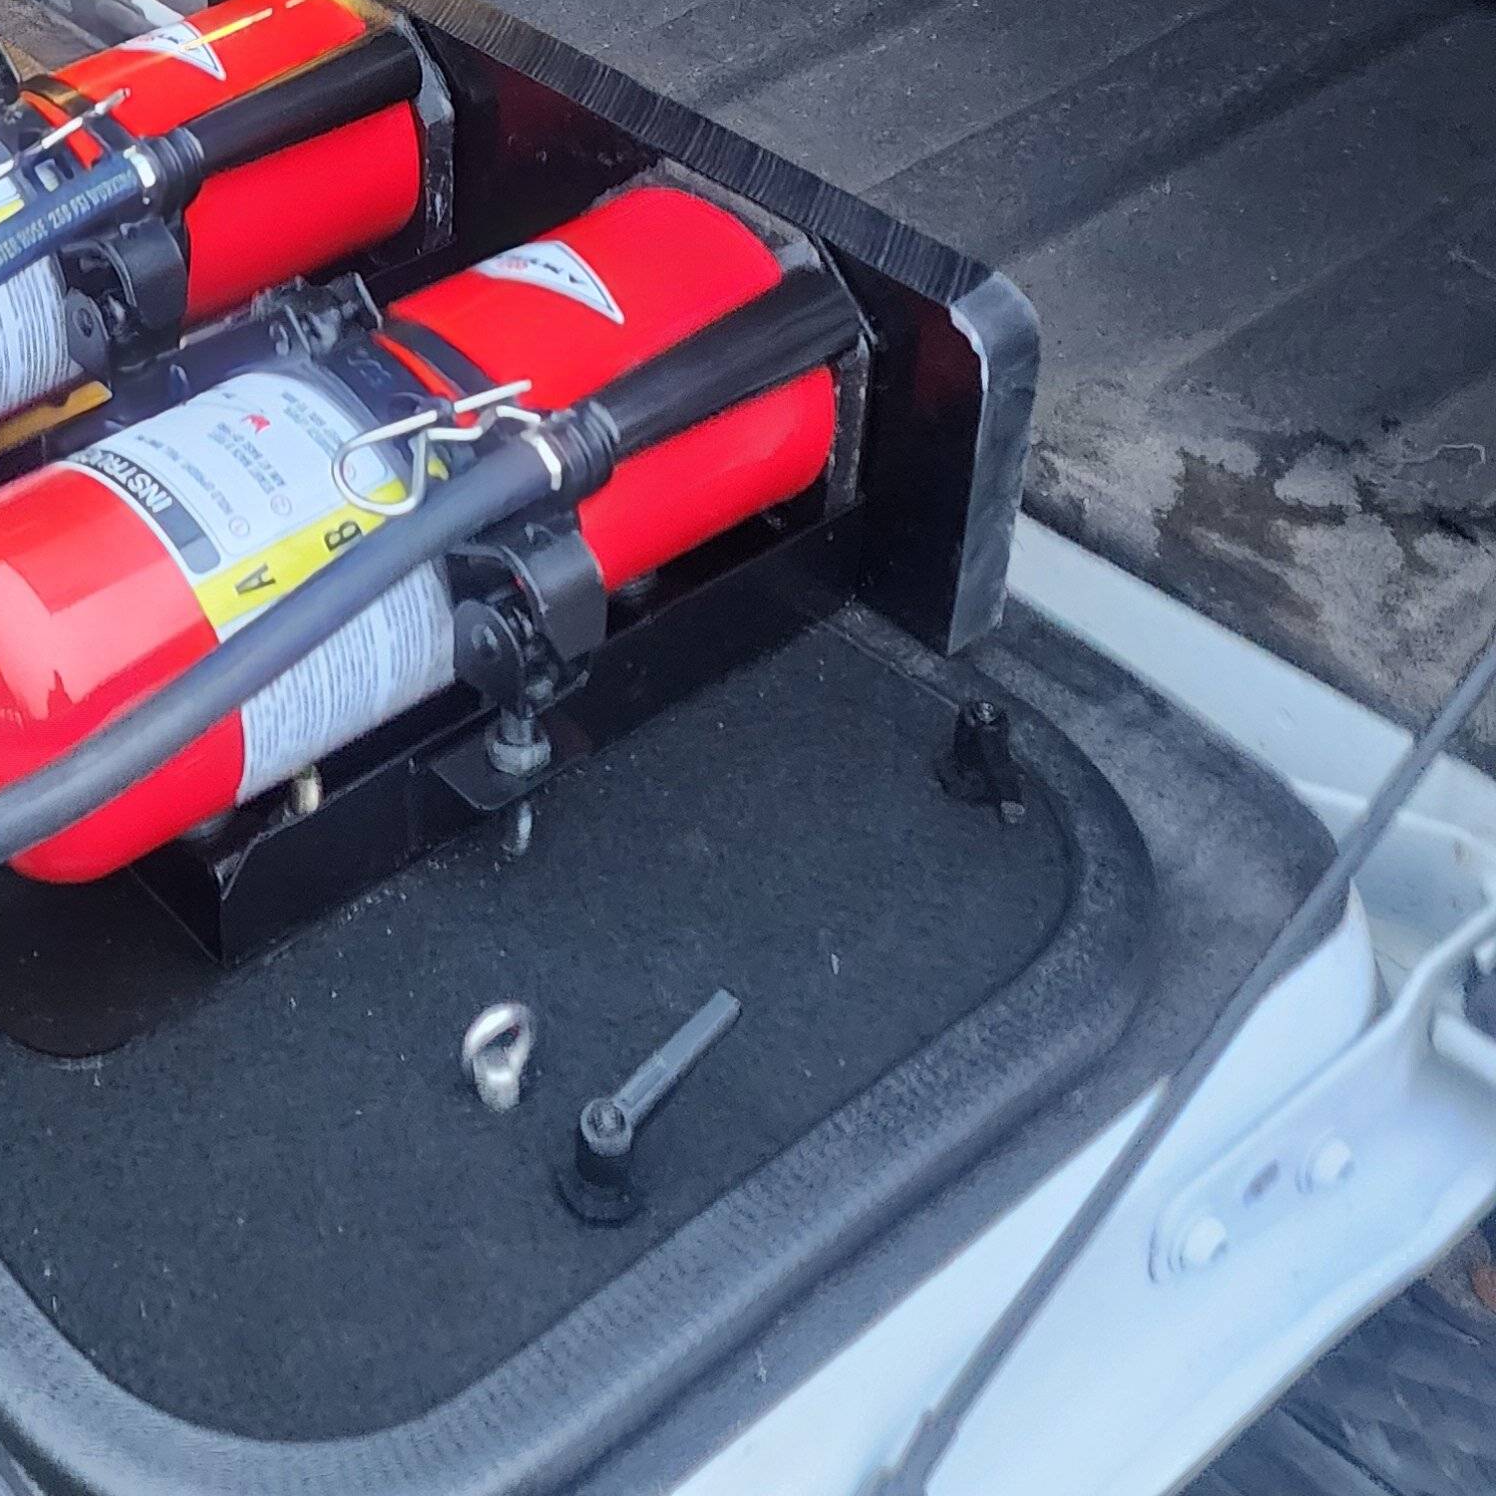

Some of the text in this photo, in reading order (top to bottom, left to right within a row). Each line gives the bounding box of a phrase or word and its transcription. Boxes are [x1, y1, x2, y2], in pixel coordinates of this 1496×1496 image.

[19, 219, 48, 248] HOSE
[235, 520, 363, 595] A B
